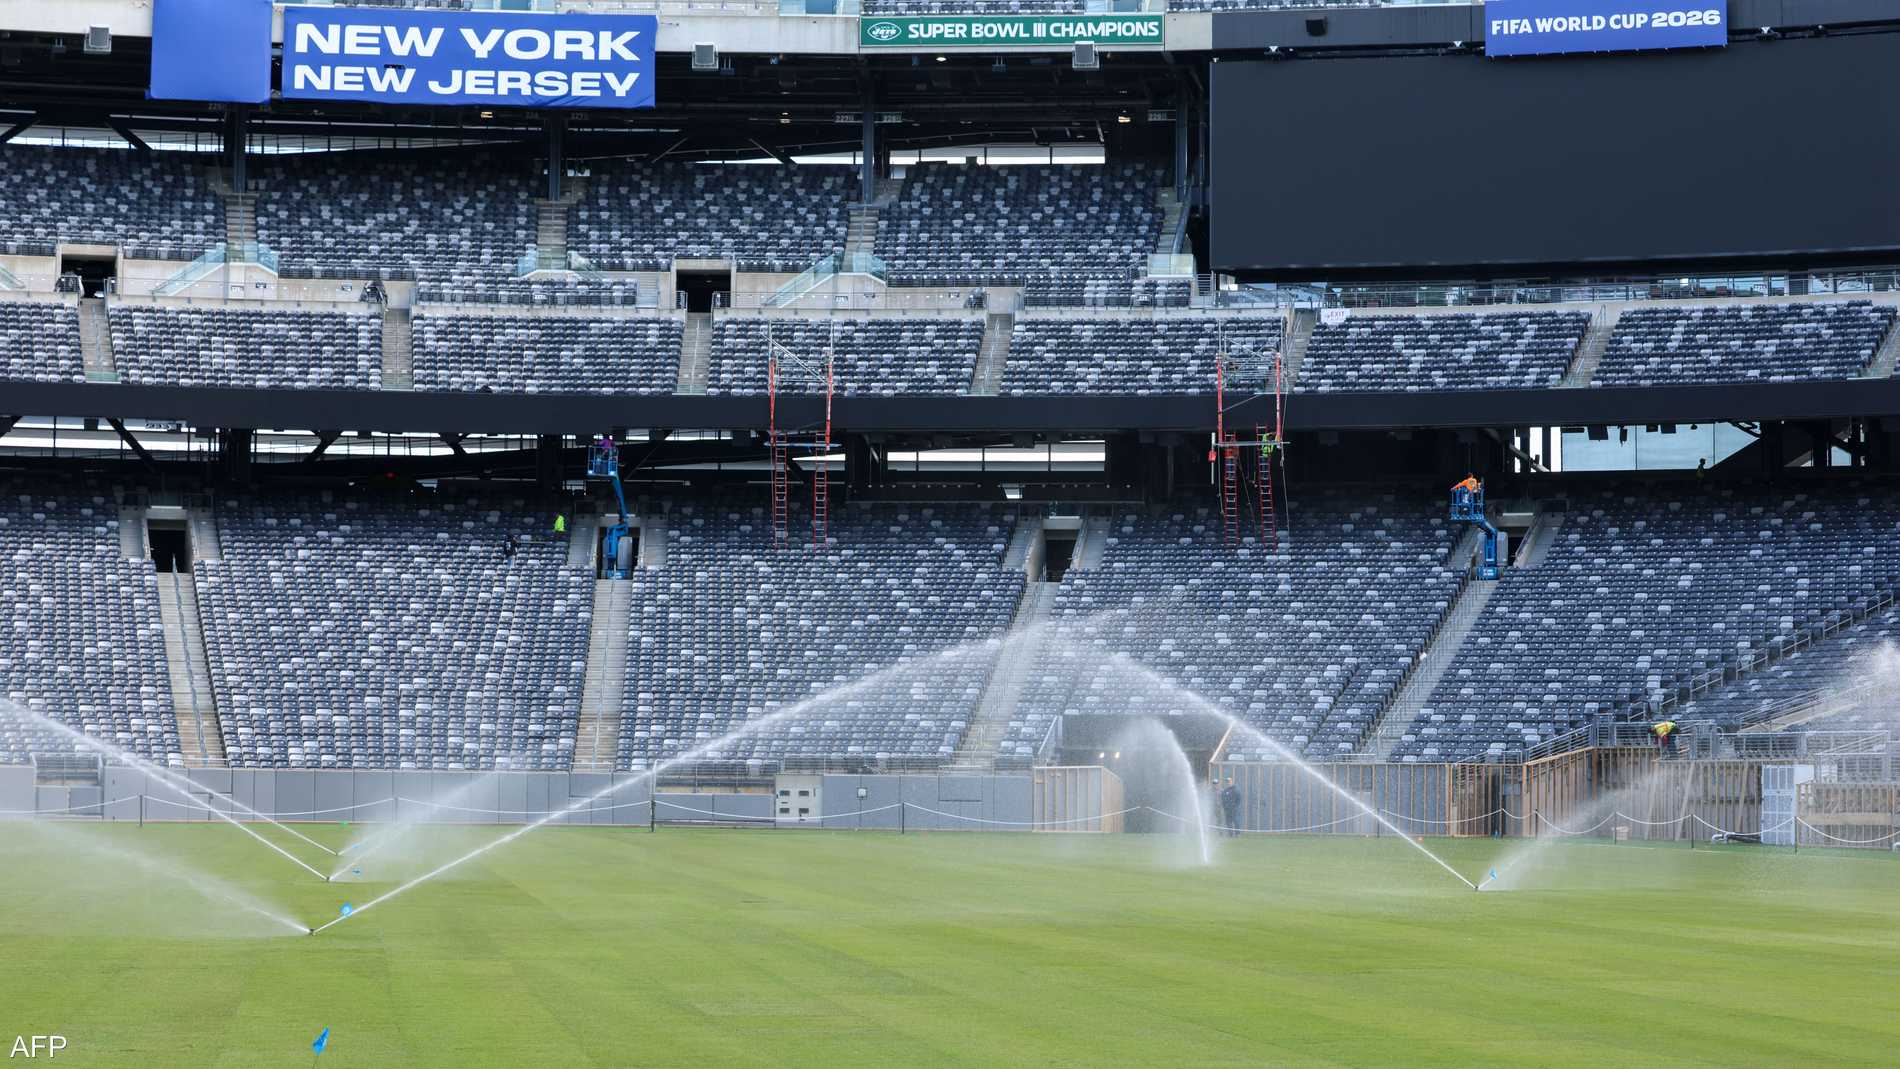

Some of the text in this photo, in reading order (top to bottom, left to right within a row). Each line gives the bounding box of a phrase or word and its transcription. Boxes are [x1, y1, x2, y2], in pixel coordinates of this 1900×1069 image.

[908, 21, 1159, 39] SUPER BOWL III CHAMPIONS
[1491, 10, 1721, 35] FIFA WORLD CUP 2026
[295, 24, 641, 61] NEW YORK
[294, 65, 640, 97] NEW JERSEY
